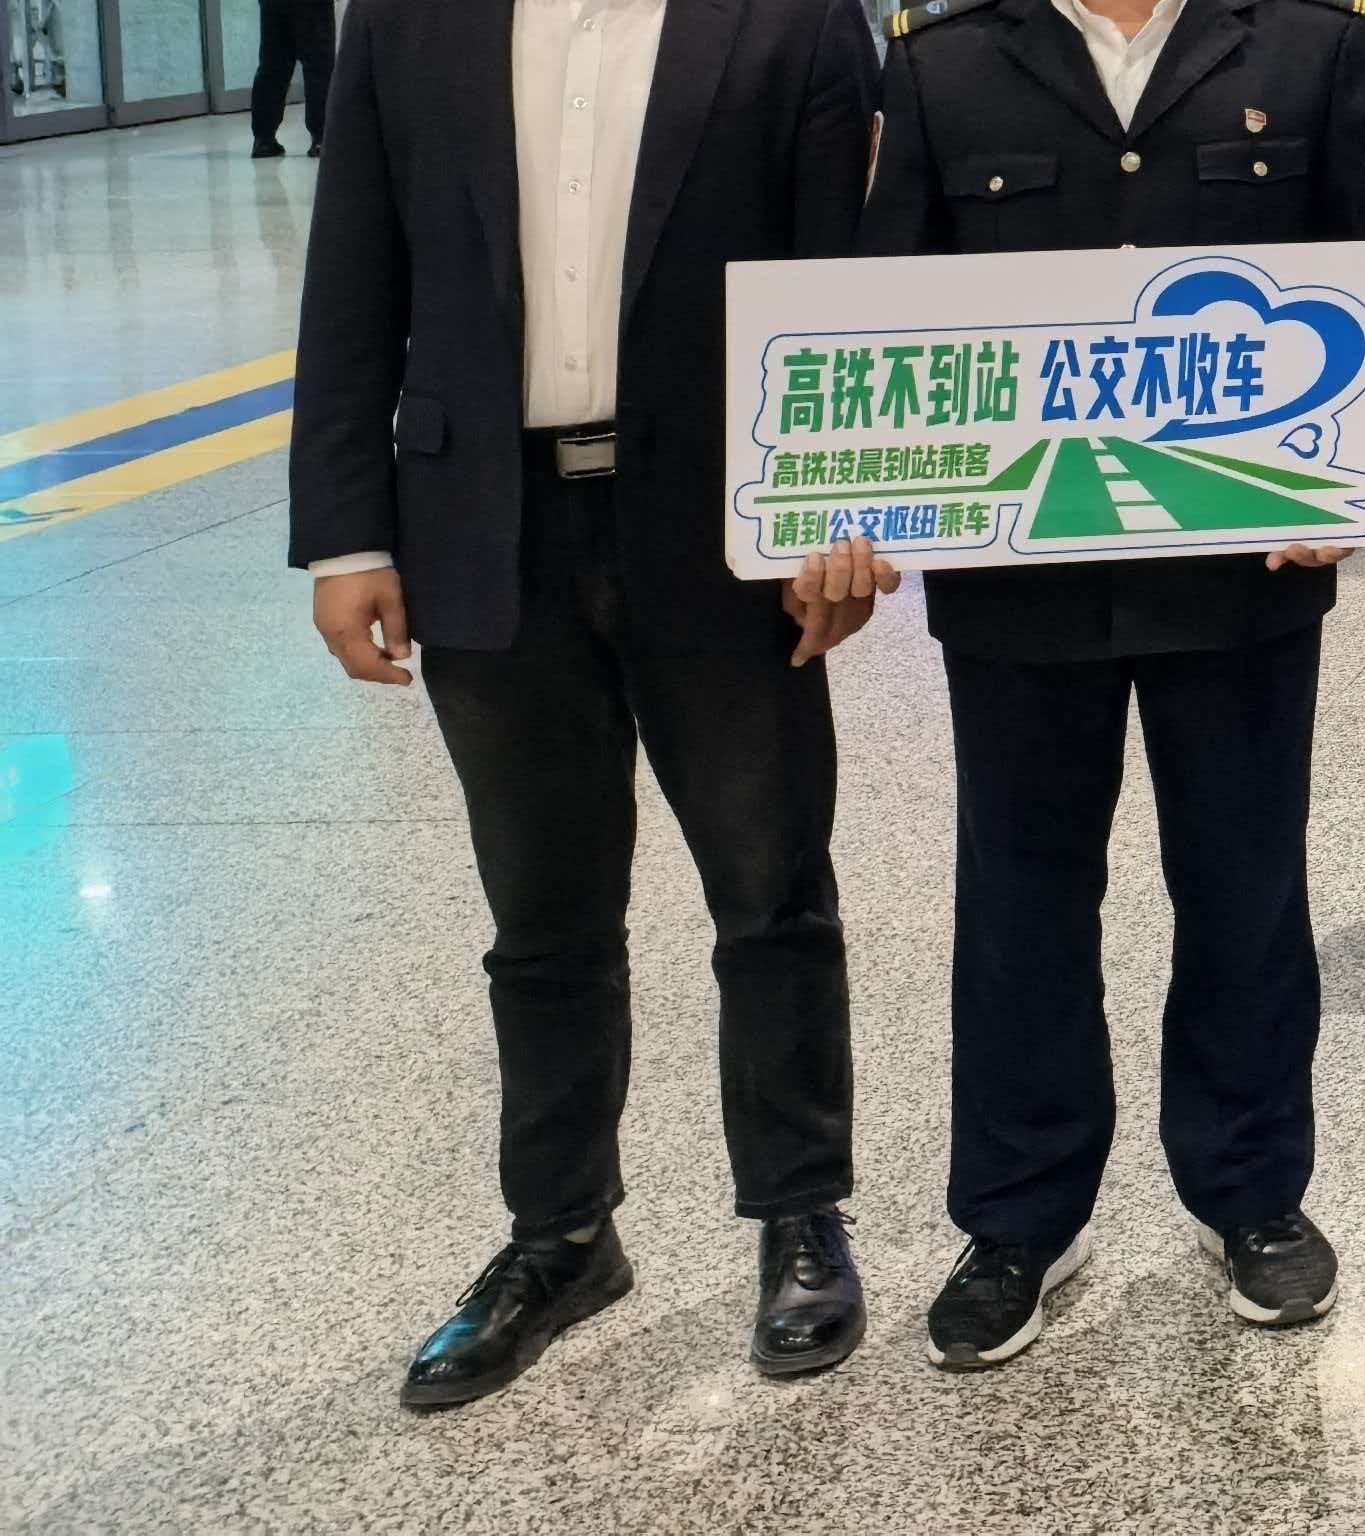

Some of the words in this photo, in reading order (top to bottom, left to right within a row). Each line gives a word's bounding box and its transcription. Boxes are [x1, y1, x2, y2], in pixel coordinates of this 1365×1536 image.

[780, 340, 1021, 435] 高铁不到站
[1039, 332, 1266, 422] 公交不收车
[773, 443, 991, 490] 高铁凌晨到站乘客
[773, 502, 991, 549] 请到公交枢纽乘车
